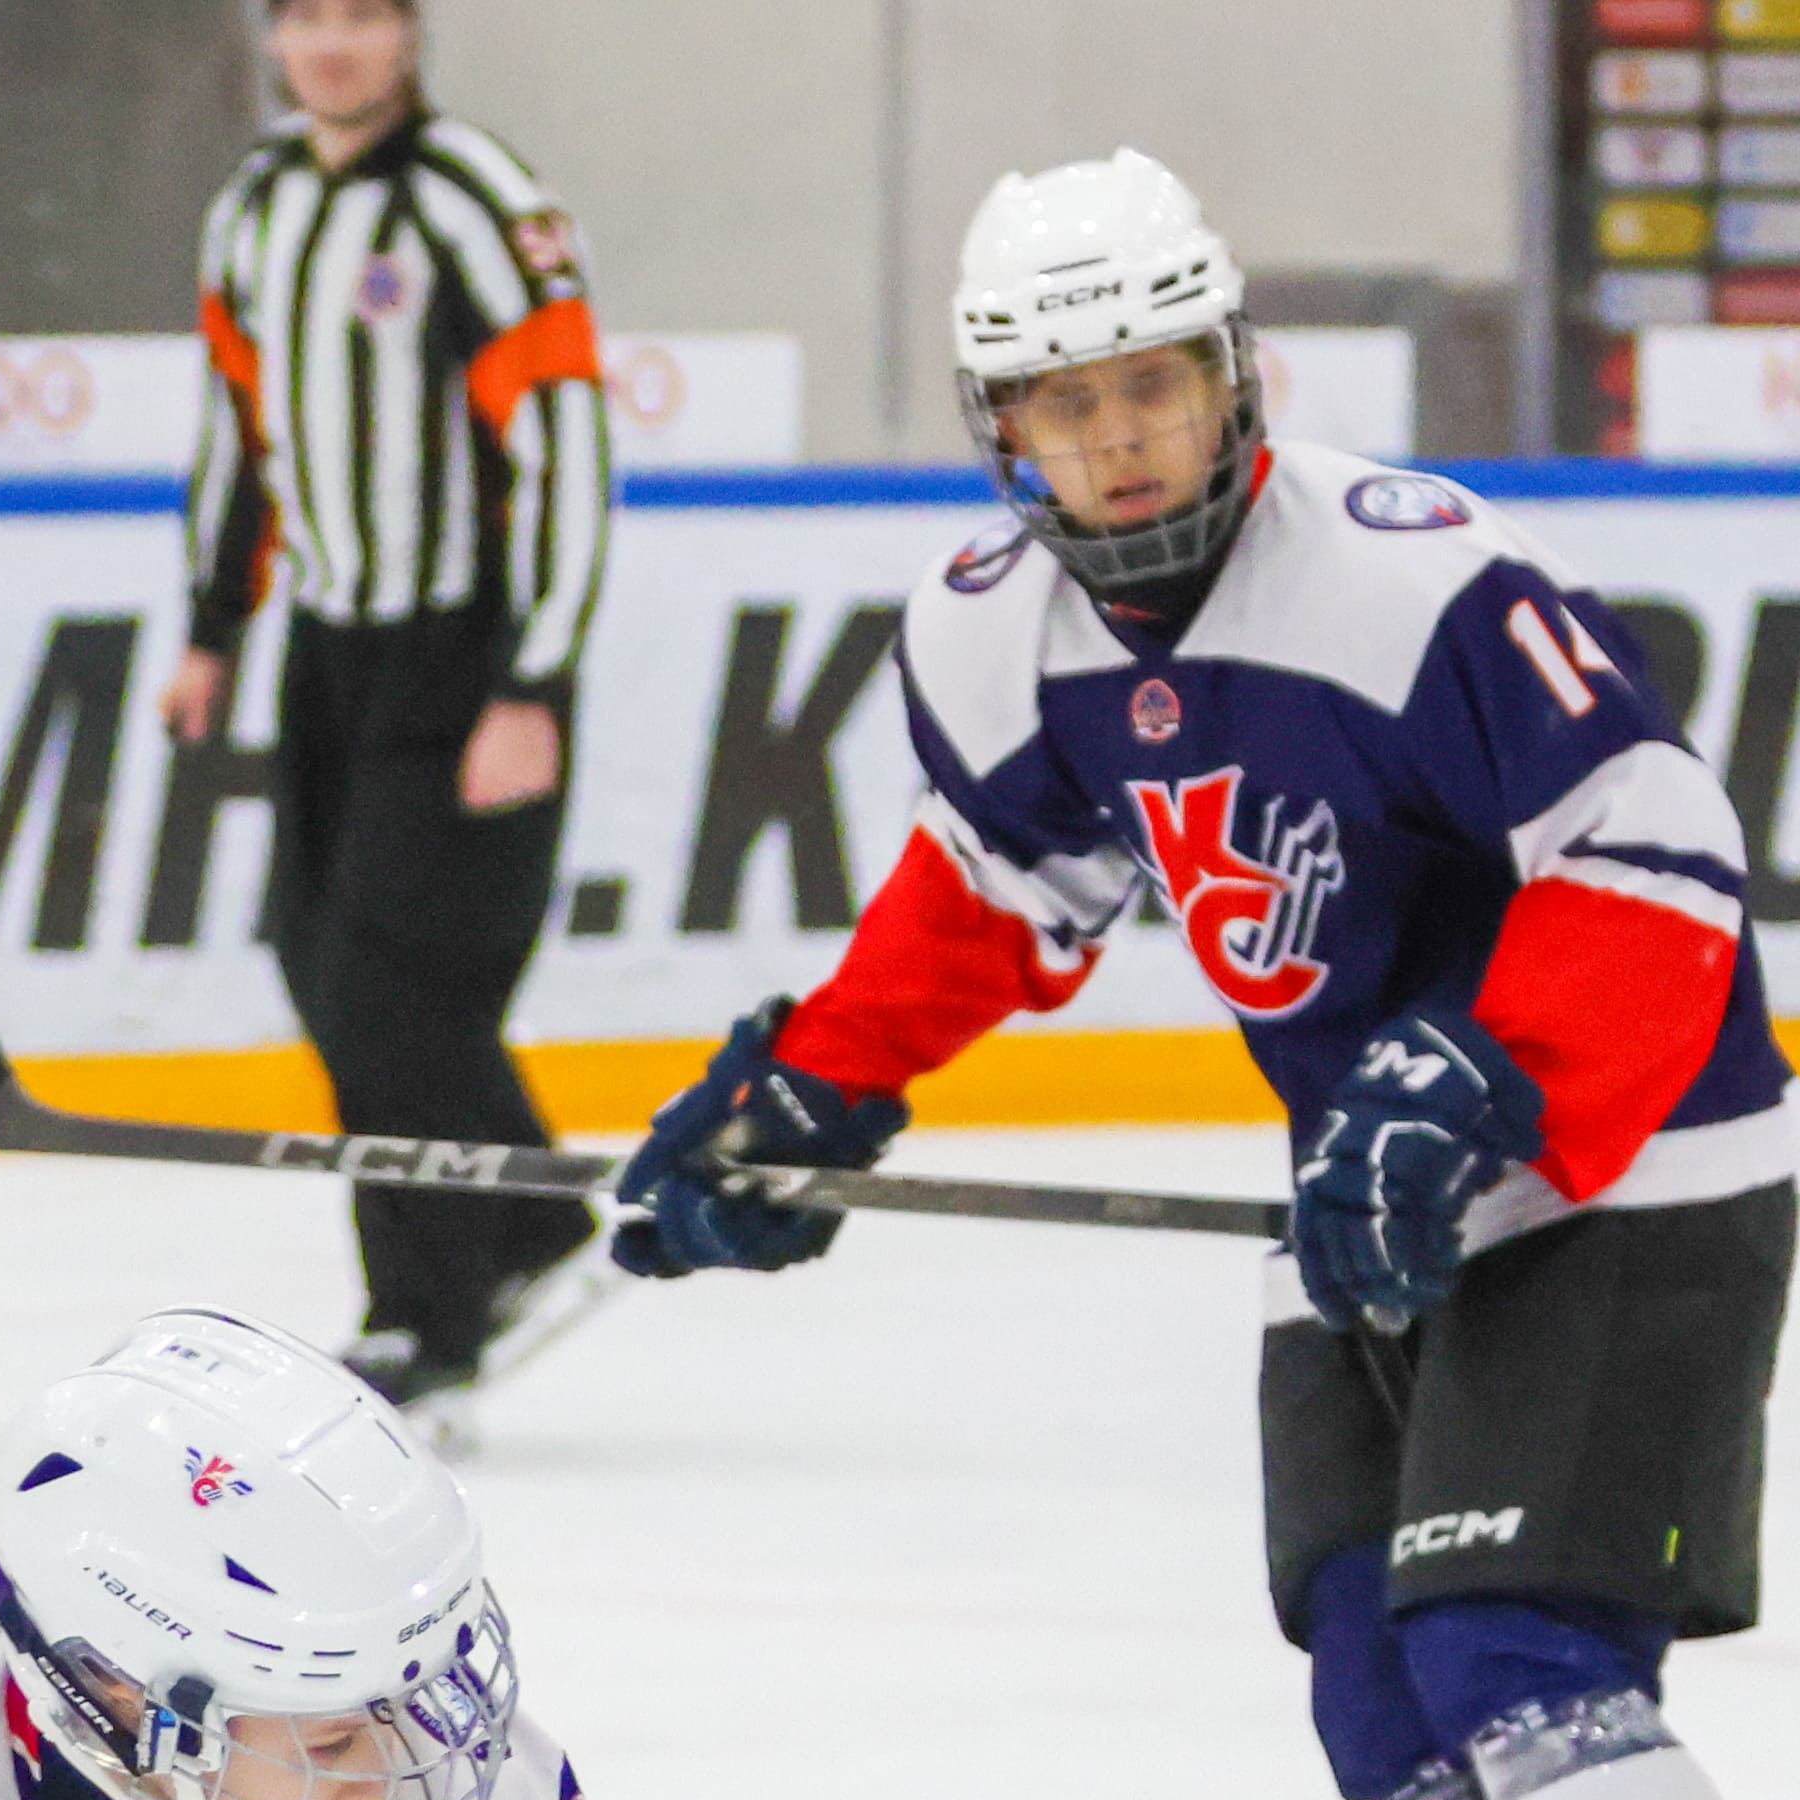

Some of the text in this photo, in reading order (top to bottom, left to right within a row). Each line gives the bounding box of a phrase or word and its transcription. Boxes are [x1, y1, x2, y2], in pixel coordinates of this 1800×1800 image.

[1036, 281, 1126, 312] CCM
[258, 1132, 516, 1186] CCM
[1390, 1505, 1526, 1568] CCM
